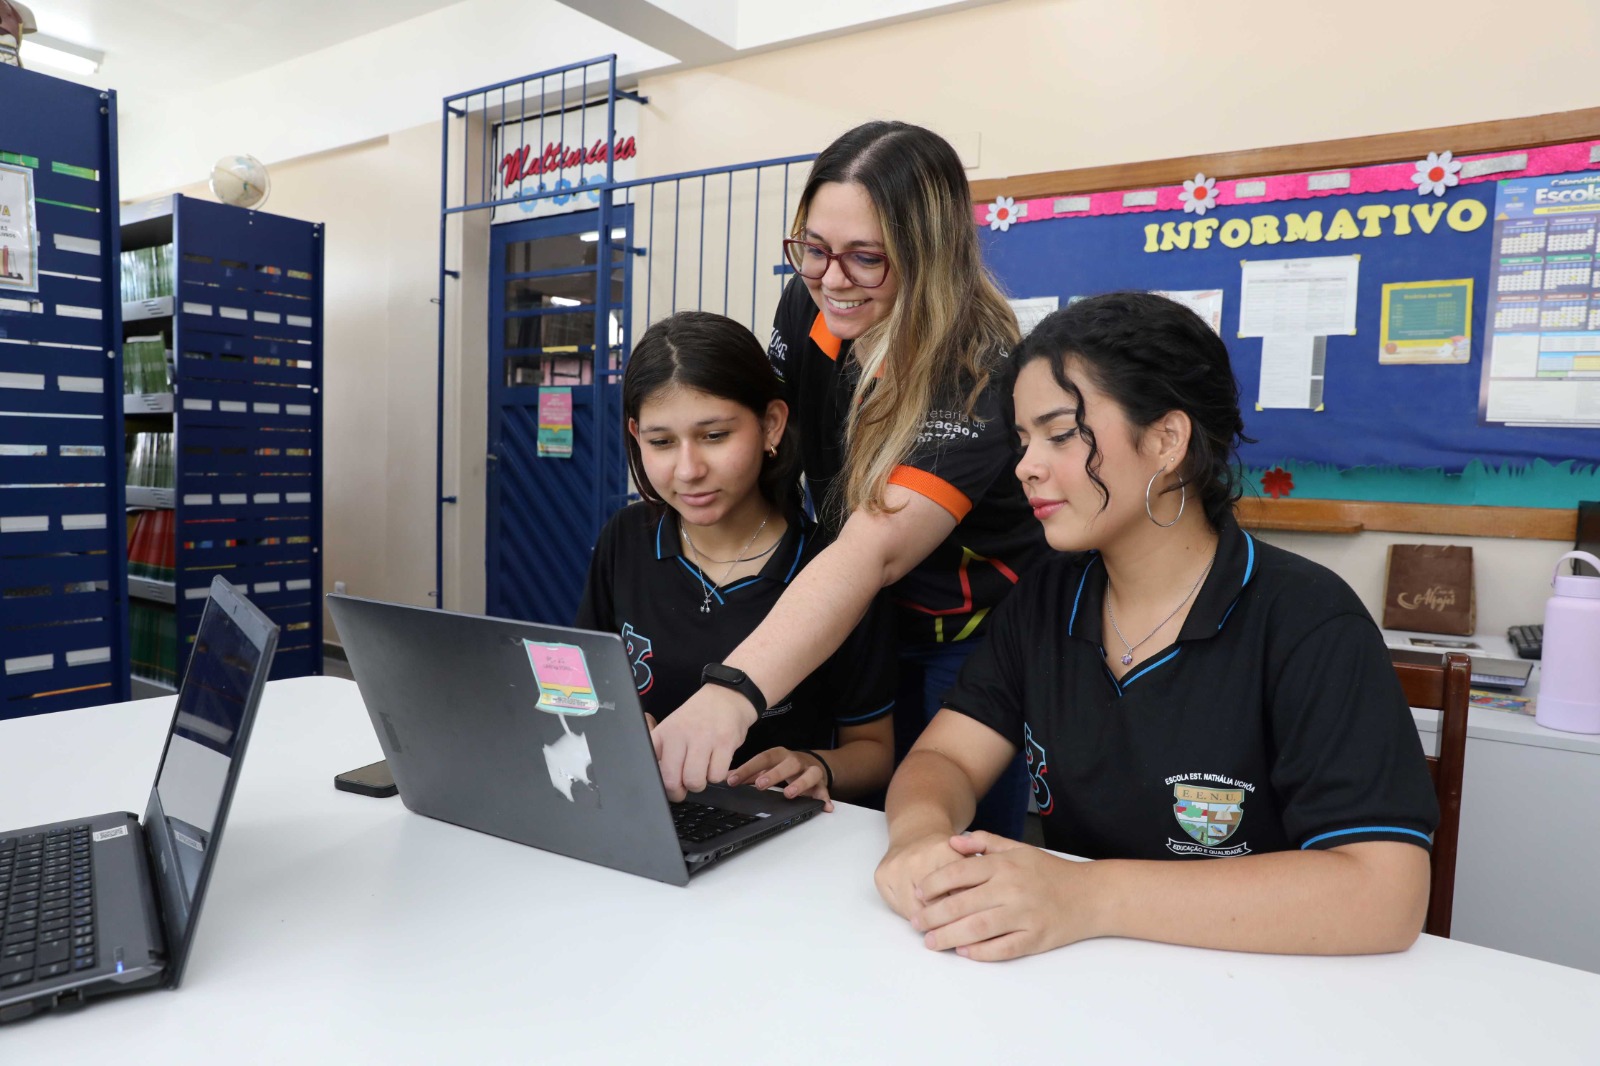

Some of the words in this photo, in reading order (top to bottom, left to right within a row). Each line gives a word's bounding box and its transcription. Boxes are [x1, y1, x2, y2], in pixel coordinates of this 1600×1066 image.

[1144, 199, 1488, 253] INFORMATIVO
[1165, 773, 1190, 786] ESCOLA
[1190, 772, 1203, 780] EST.
[1204, 773, 1234, 786] NATHÁLIA
[1172, 843, 1203, 853] EDUCAÇÃO
[1208, 847, 1243, 856] QUALIDADE
